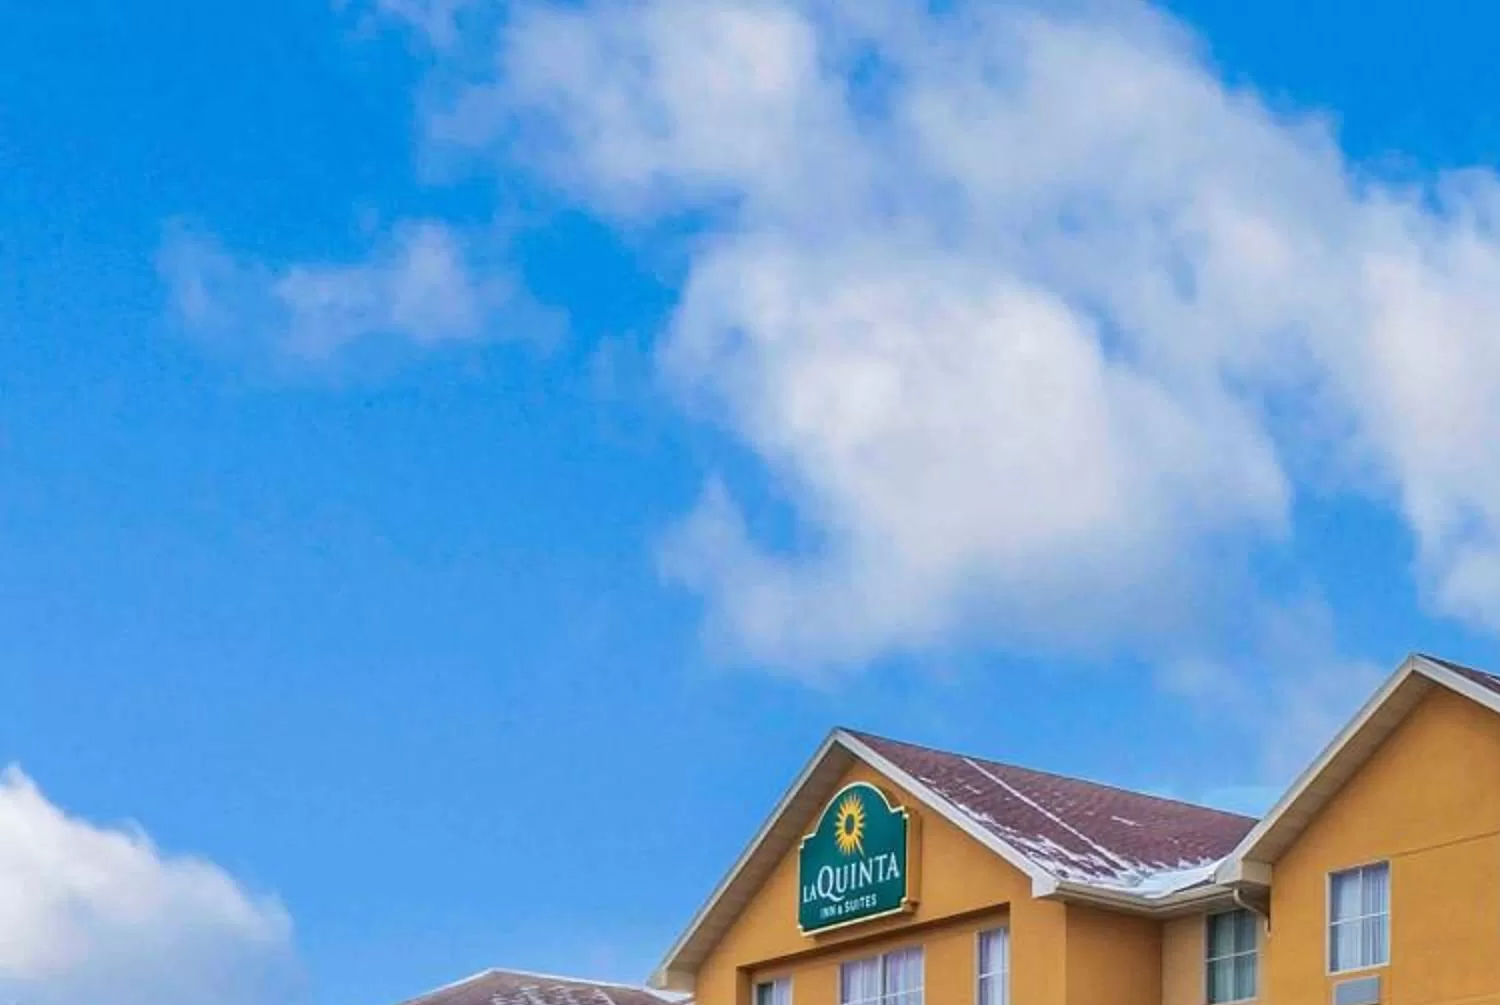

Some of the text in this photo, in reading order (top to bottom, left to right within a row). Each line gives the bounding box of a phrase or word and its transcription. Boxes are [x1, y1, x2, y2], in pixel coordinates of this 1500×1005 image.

[803, 852, 900, 903] LA QUINTA
[820, 905, 837, 919] INN
[845, 893, 877, 913] SUITES
